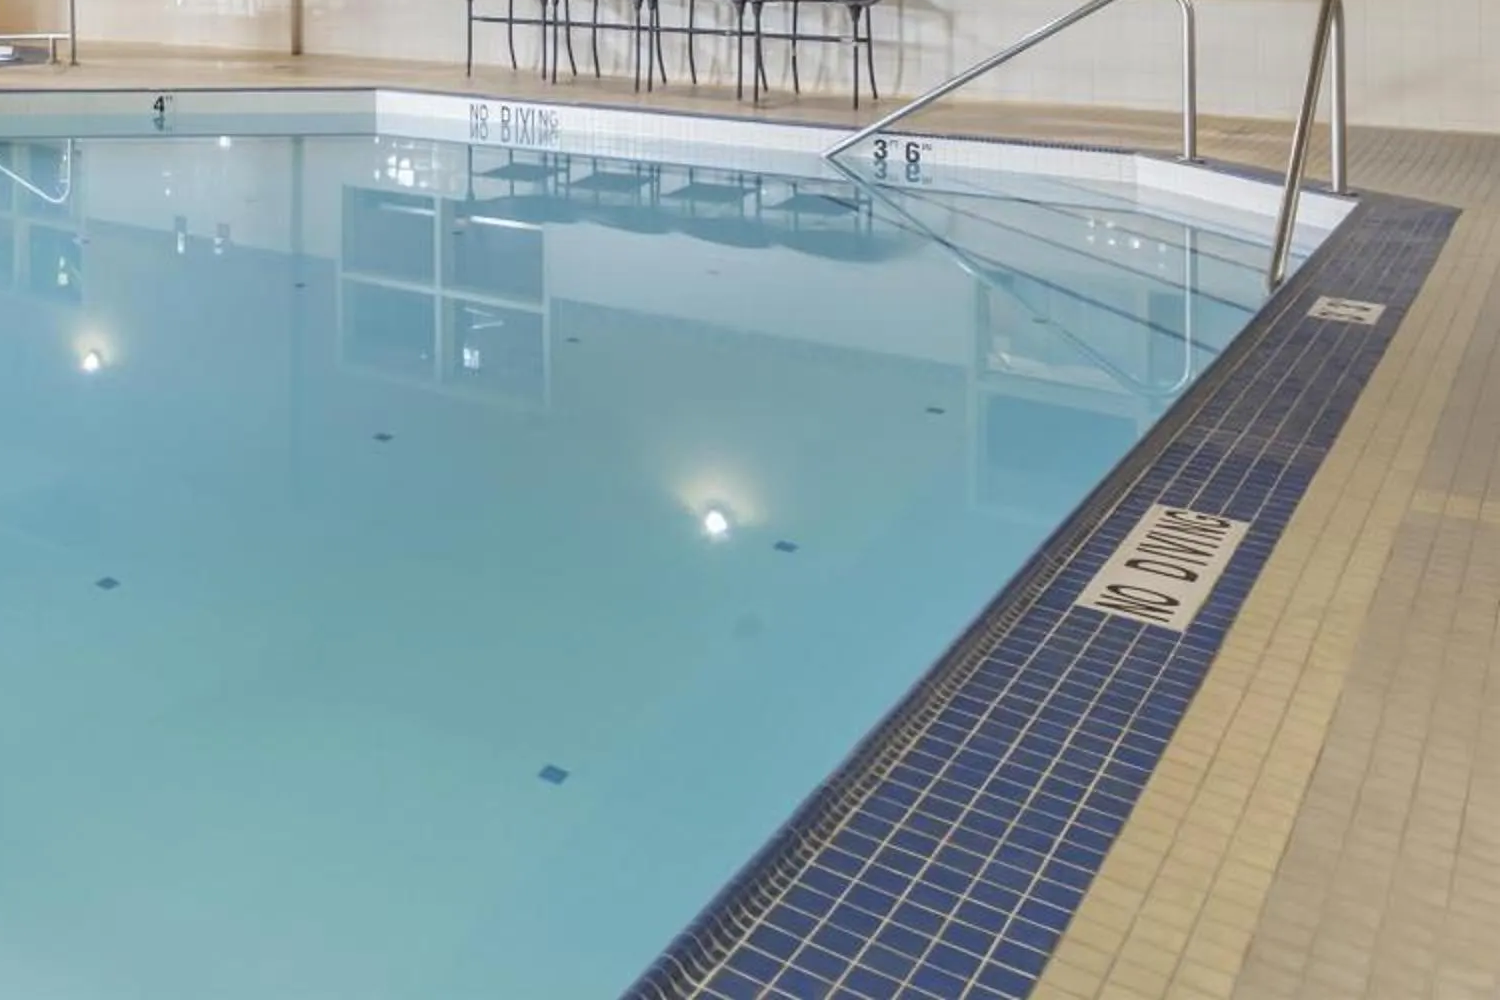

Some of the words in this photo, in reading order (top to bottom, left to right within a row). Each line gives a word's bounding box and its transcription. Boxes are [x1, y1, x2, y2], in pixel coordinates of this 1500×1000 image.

[154, 95, 164, 112] 4
[469, 103, 488, 120] NO
[501, 105, 558, 129] DIVING
[873, 139, 887, 159] 3
[906, 141, 920, 163] 6
[1124, 510, 1231, 583] DIVING
[1094, 584, 1181, 623] NO
